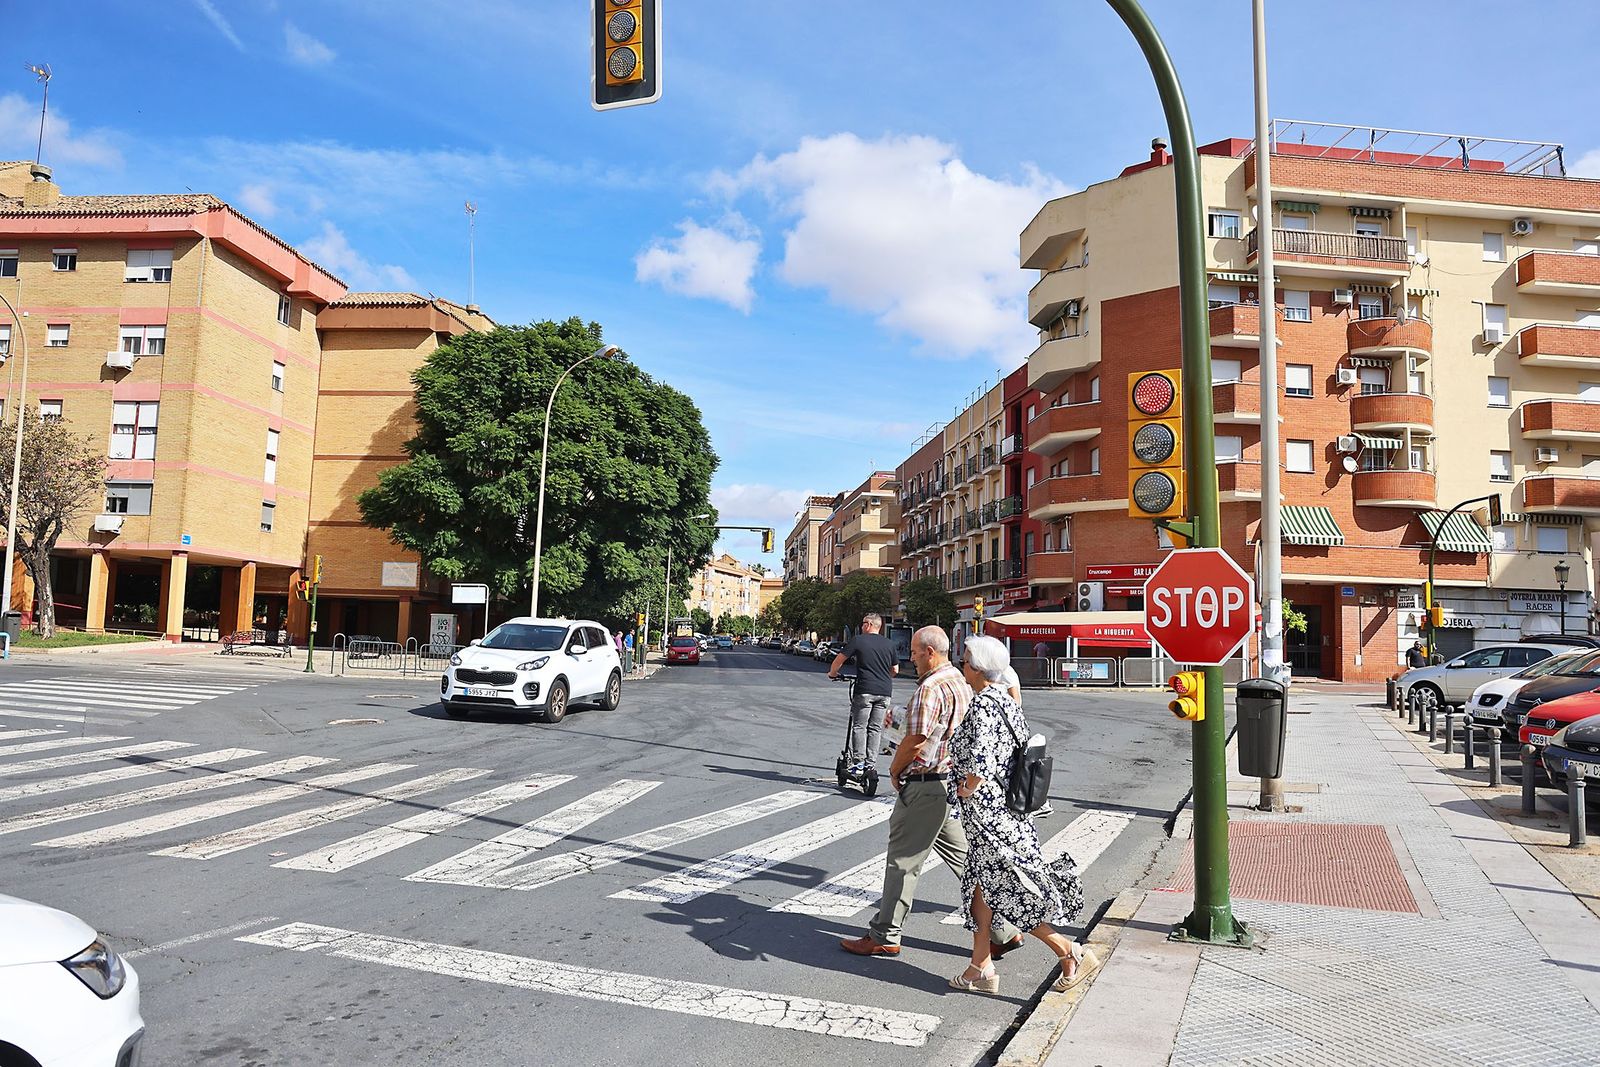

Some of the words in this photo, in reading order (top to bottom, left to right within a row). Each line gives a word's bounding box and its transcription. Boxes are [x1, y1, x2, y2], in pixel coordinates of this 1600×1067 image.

[1133, 568, 1145, 576] BAR
[1145, 568, 1152, 576] LA
[1510, 592, 1537, 601] JOYERIA
[1537, 592, 1568, 602] MARAVR
[1151, 585, 1245, 628] STOP
[1526, 602, 1553, 611] RACER
[1443, 618, 1473, 627] OJERIA
